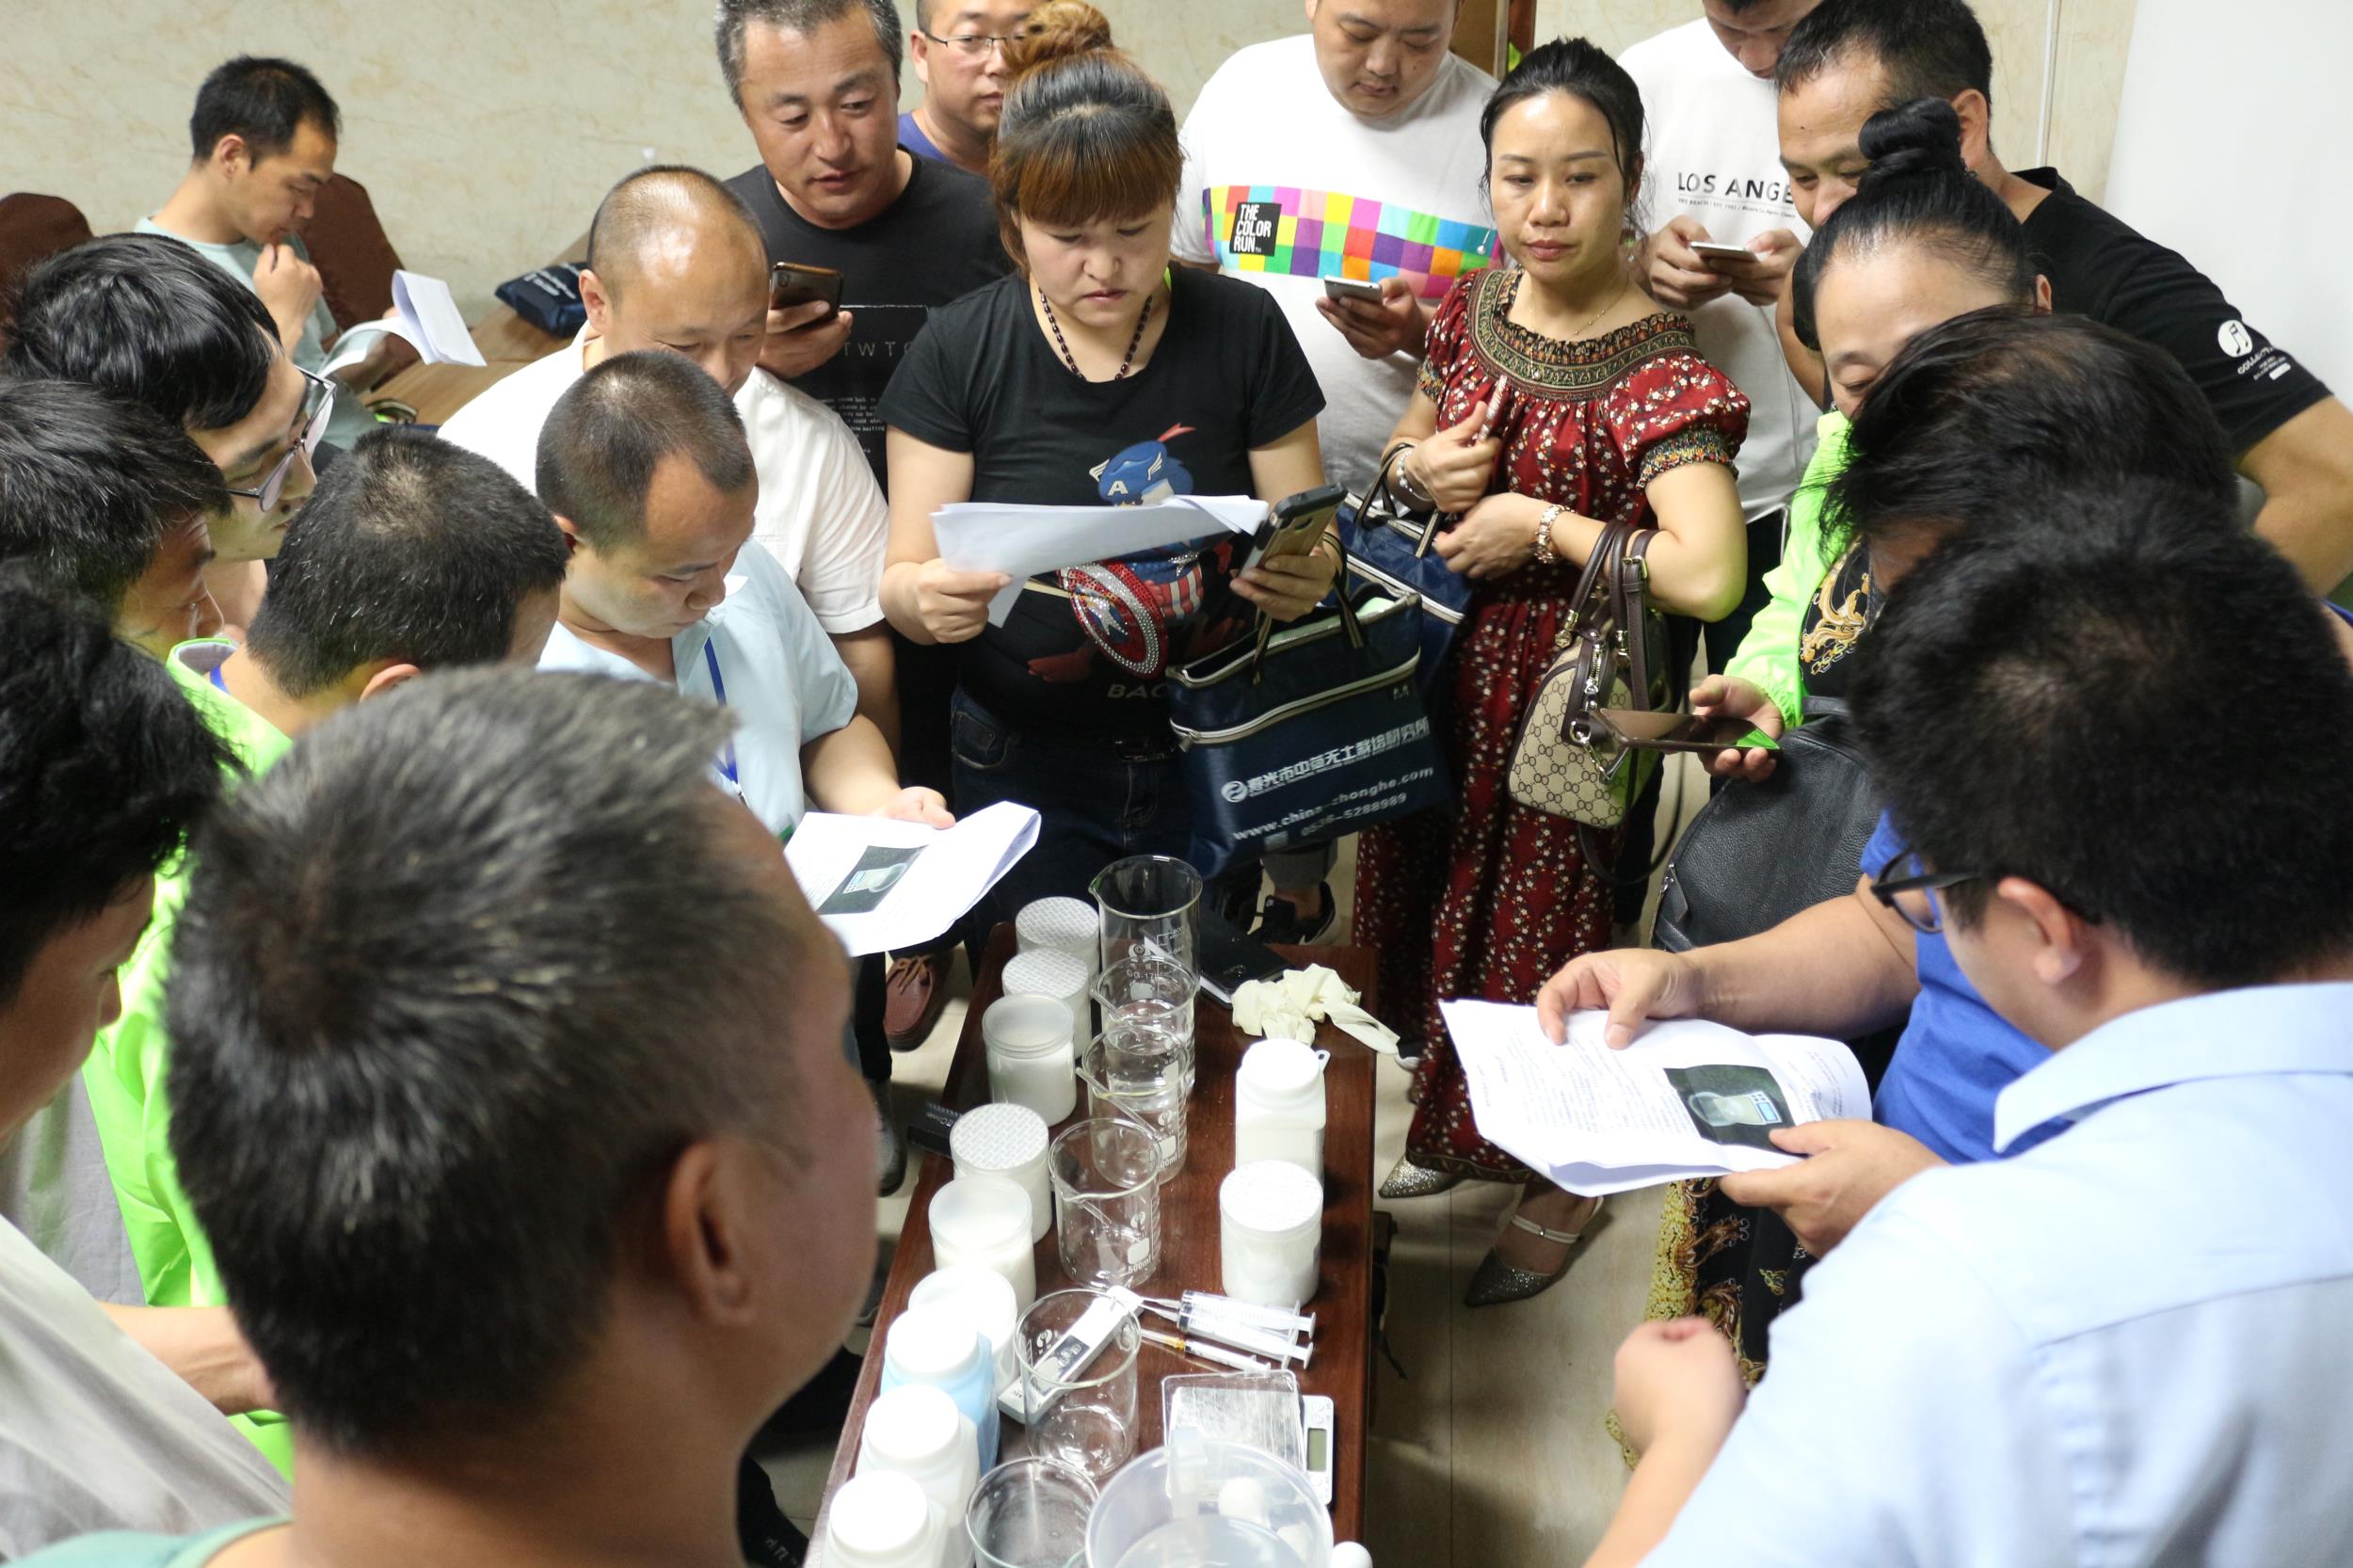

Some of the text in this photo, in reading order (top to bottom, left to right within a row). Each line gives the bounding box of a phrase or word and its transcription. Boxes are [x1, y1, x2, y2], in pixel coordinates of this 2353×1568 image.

[1678, 172, 1794, 205] LOS ANGE
[1240, 203, 1260, 221] THE
[1235, 219, 1273, 238] COLOR
[1233, 235, 1257, 253] RUN
[1107, 480, 1129, 497] A
